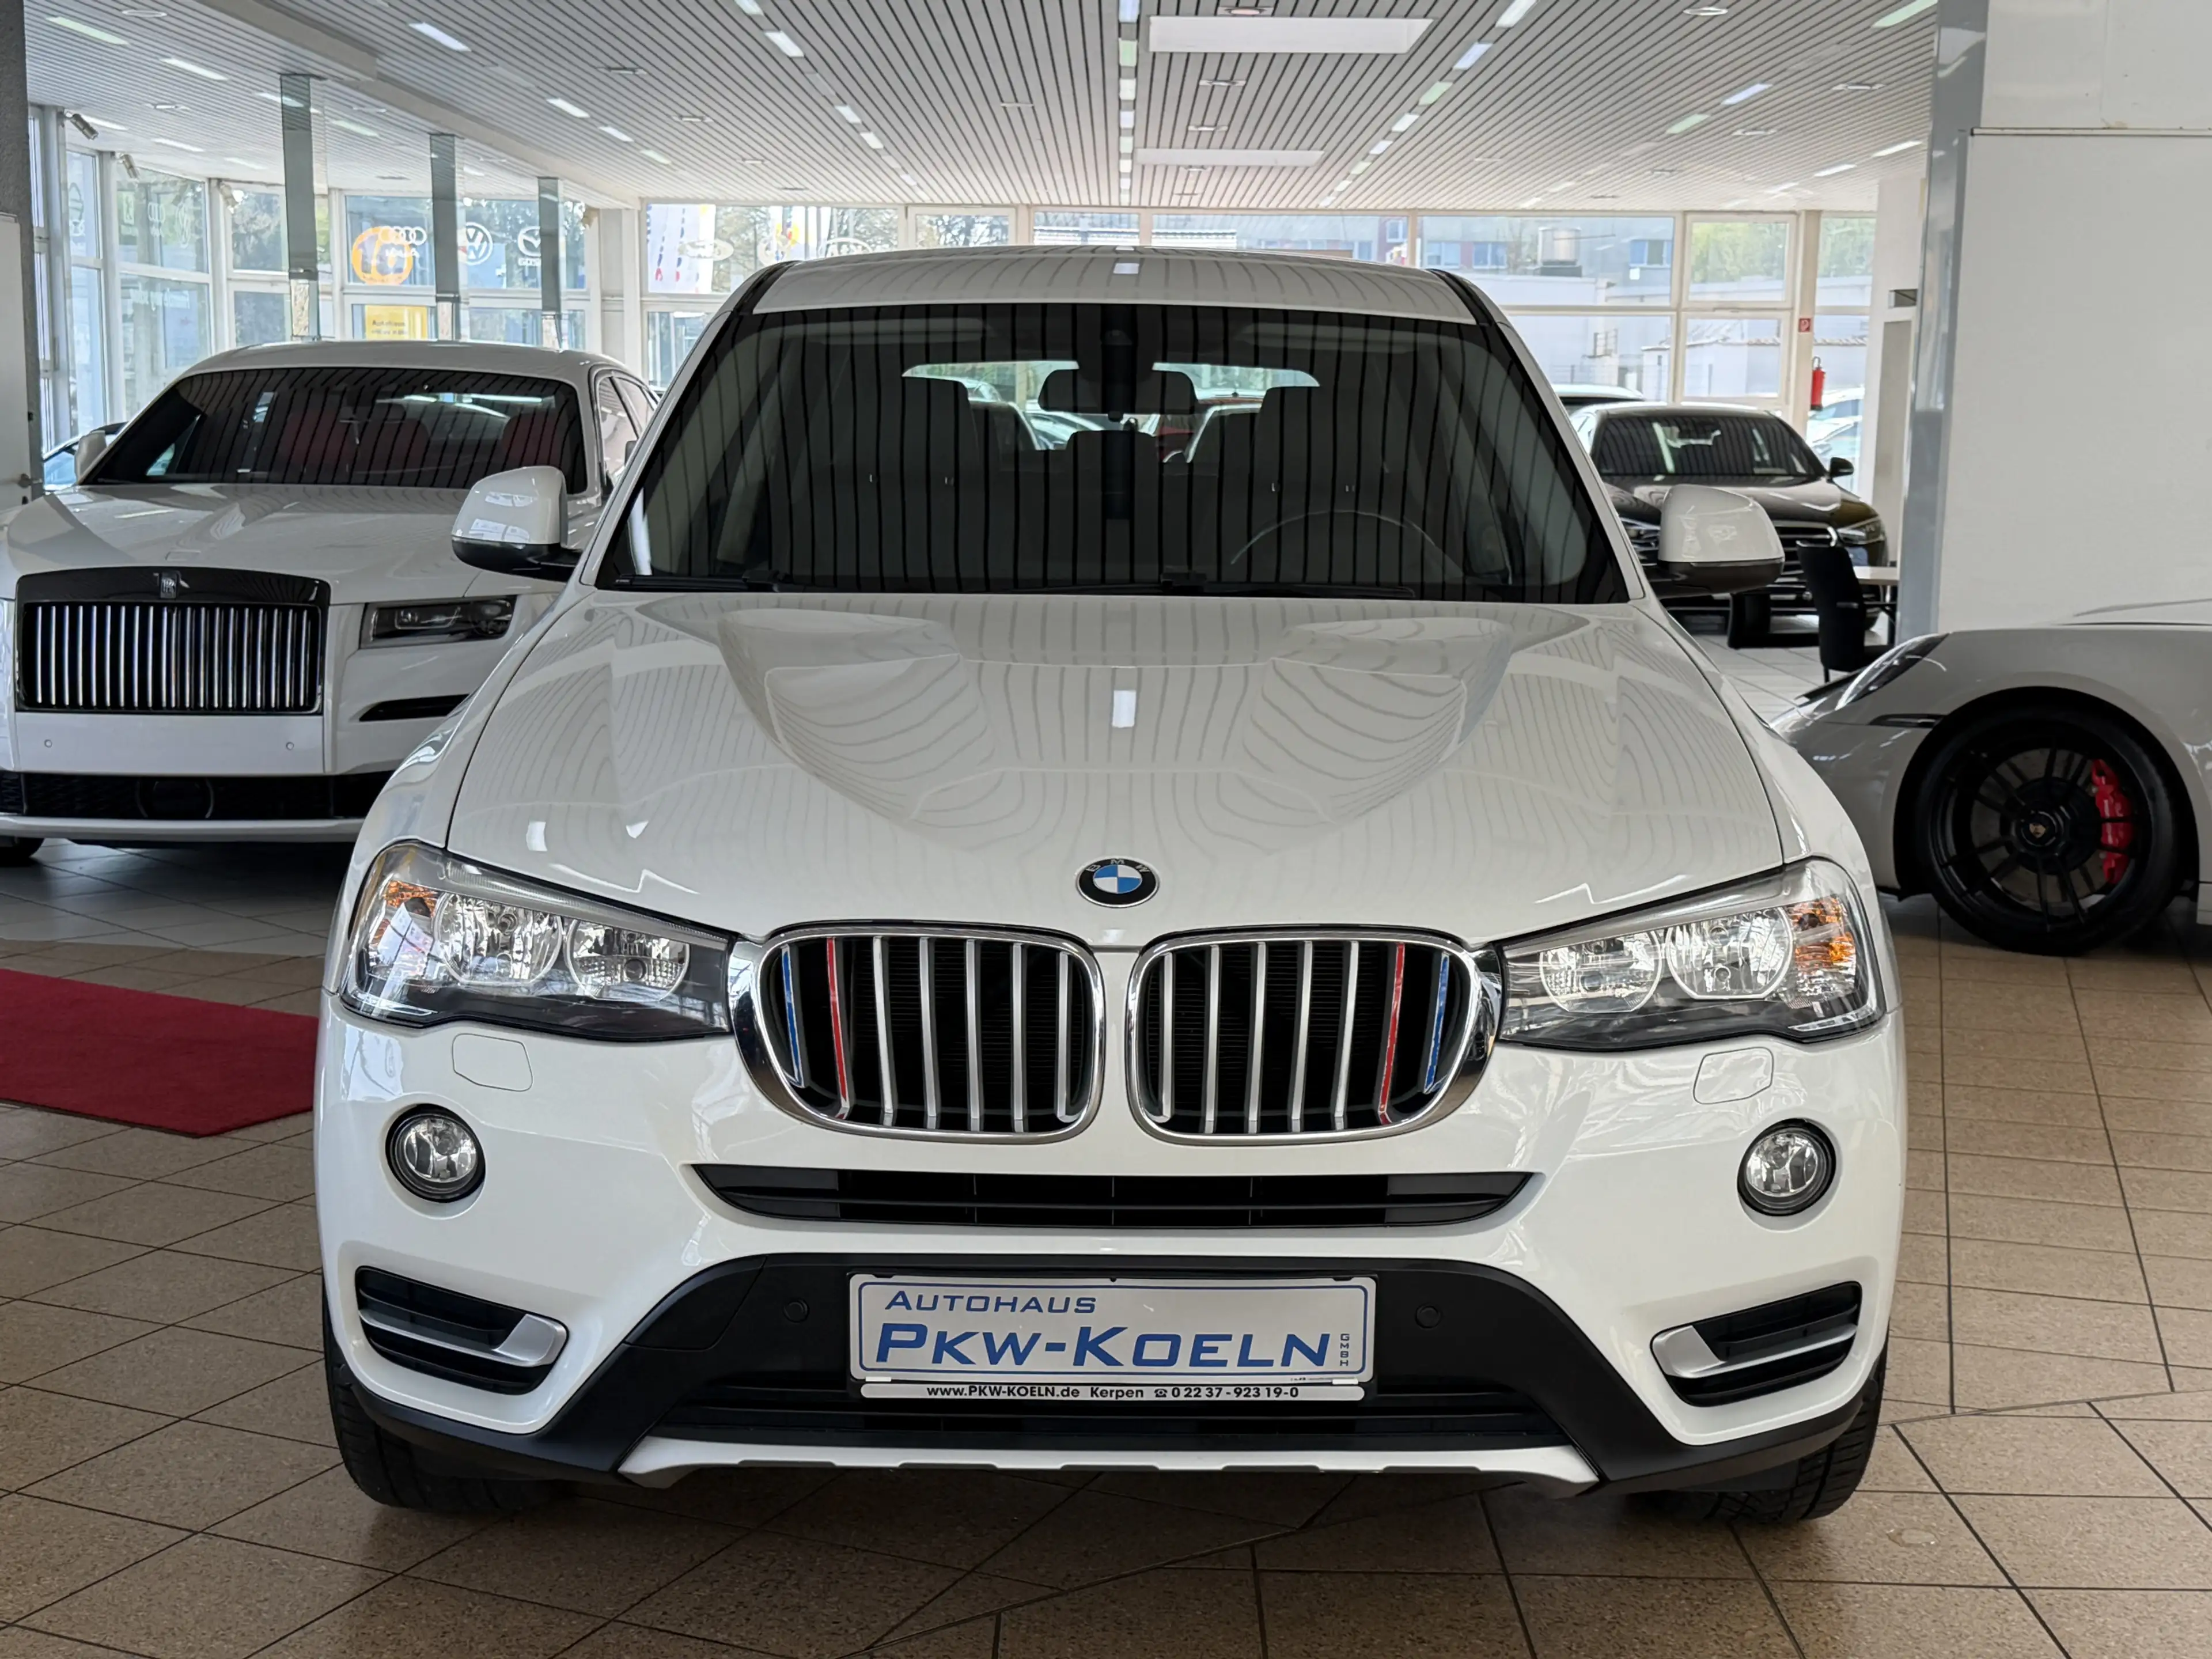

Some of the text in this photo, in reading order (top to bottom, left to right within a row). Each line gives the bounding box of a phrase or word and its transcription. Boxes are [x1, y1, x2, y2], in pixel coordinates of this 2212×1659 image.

[1086, 858, 1151, 873] BMW
[885, 1290, 1097, 1313] AUTOHAUS
[926, 1385, 1081, 1398] www.PKW-KOELN.de
[1090, 1387, 1144, 1400] Kerpen
